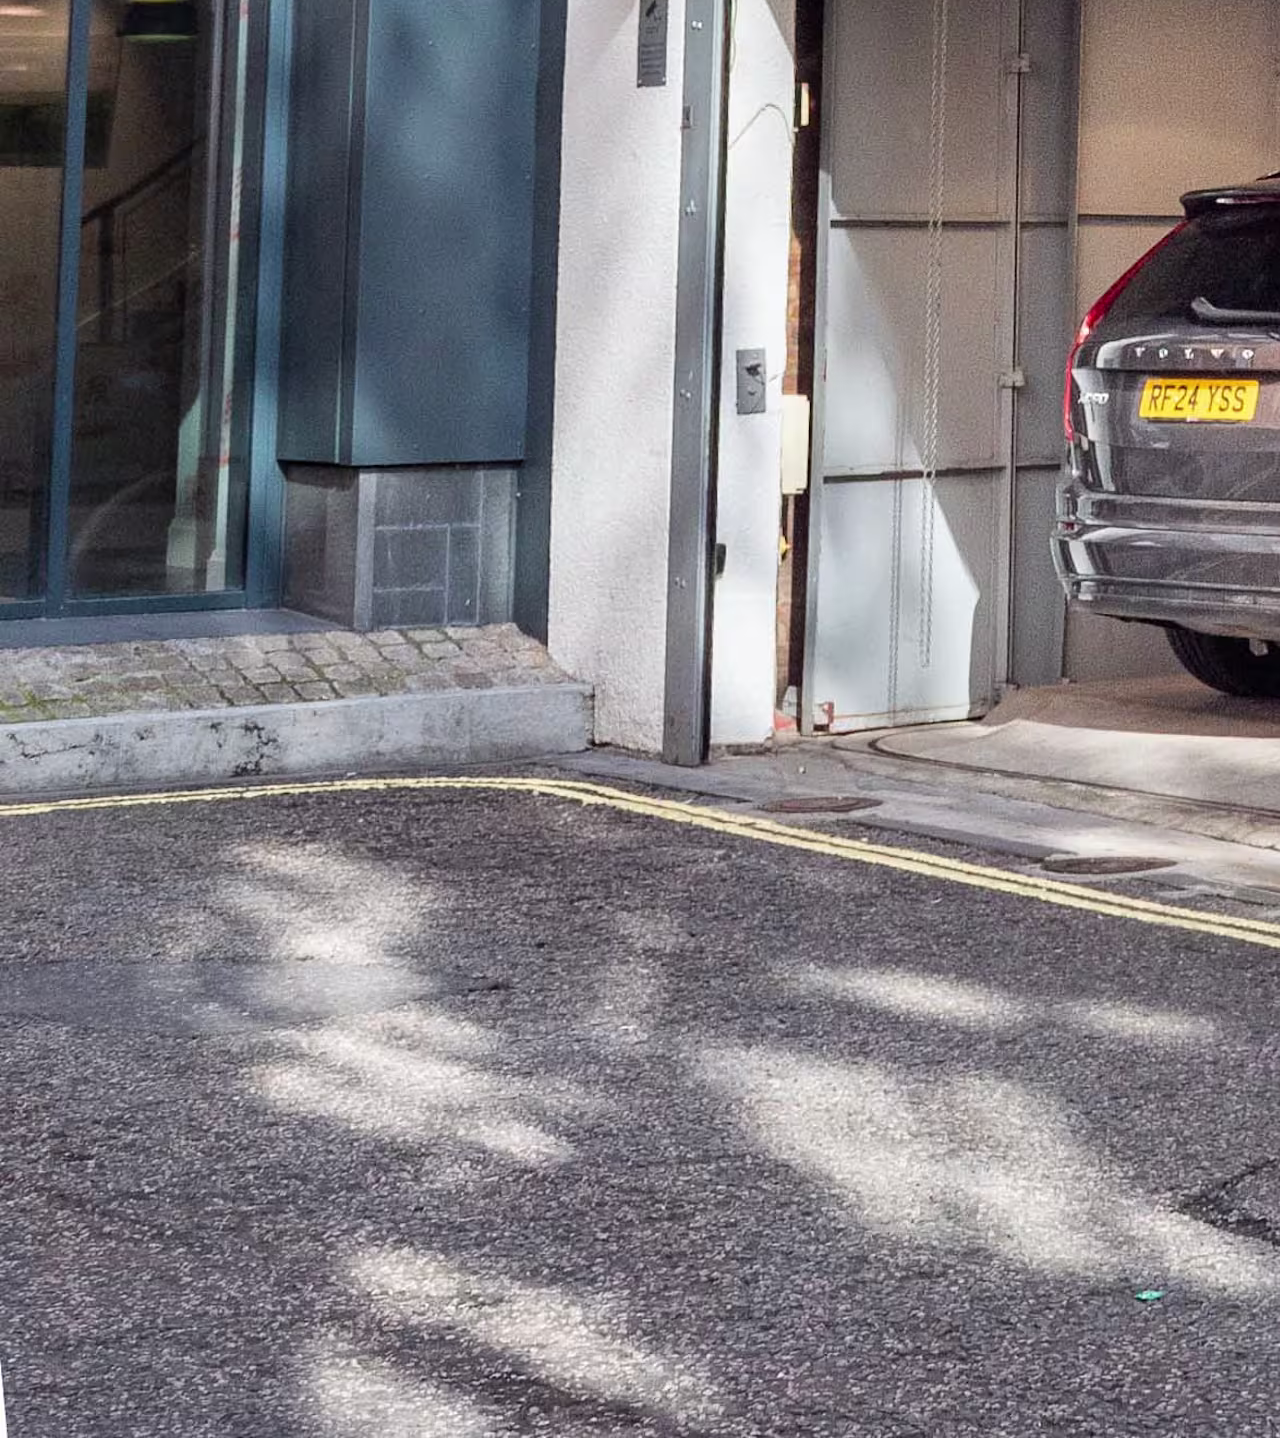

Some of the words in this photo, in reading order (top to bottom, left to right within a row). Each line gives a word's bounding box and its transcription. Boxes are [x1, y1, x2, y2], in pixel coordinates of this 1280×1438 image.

[1134, 346, 1255, 360] VOLVO
[1149, 384, 1199, 412] RF24
[1207, 385, 1247, 412] YSS
